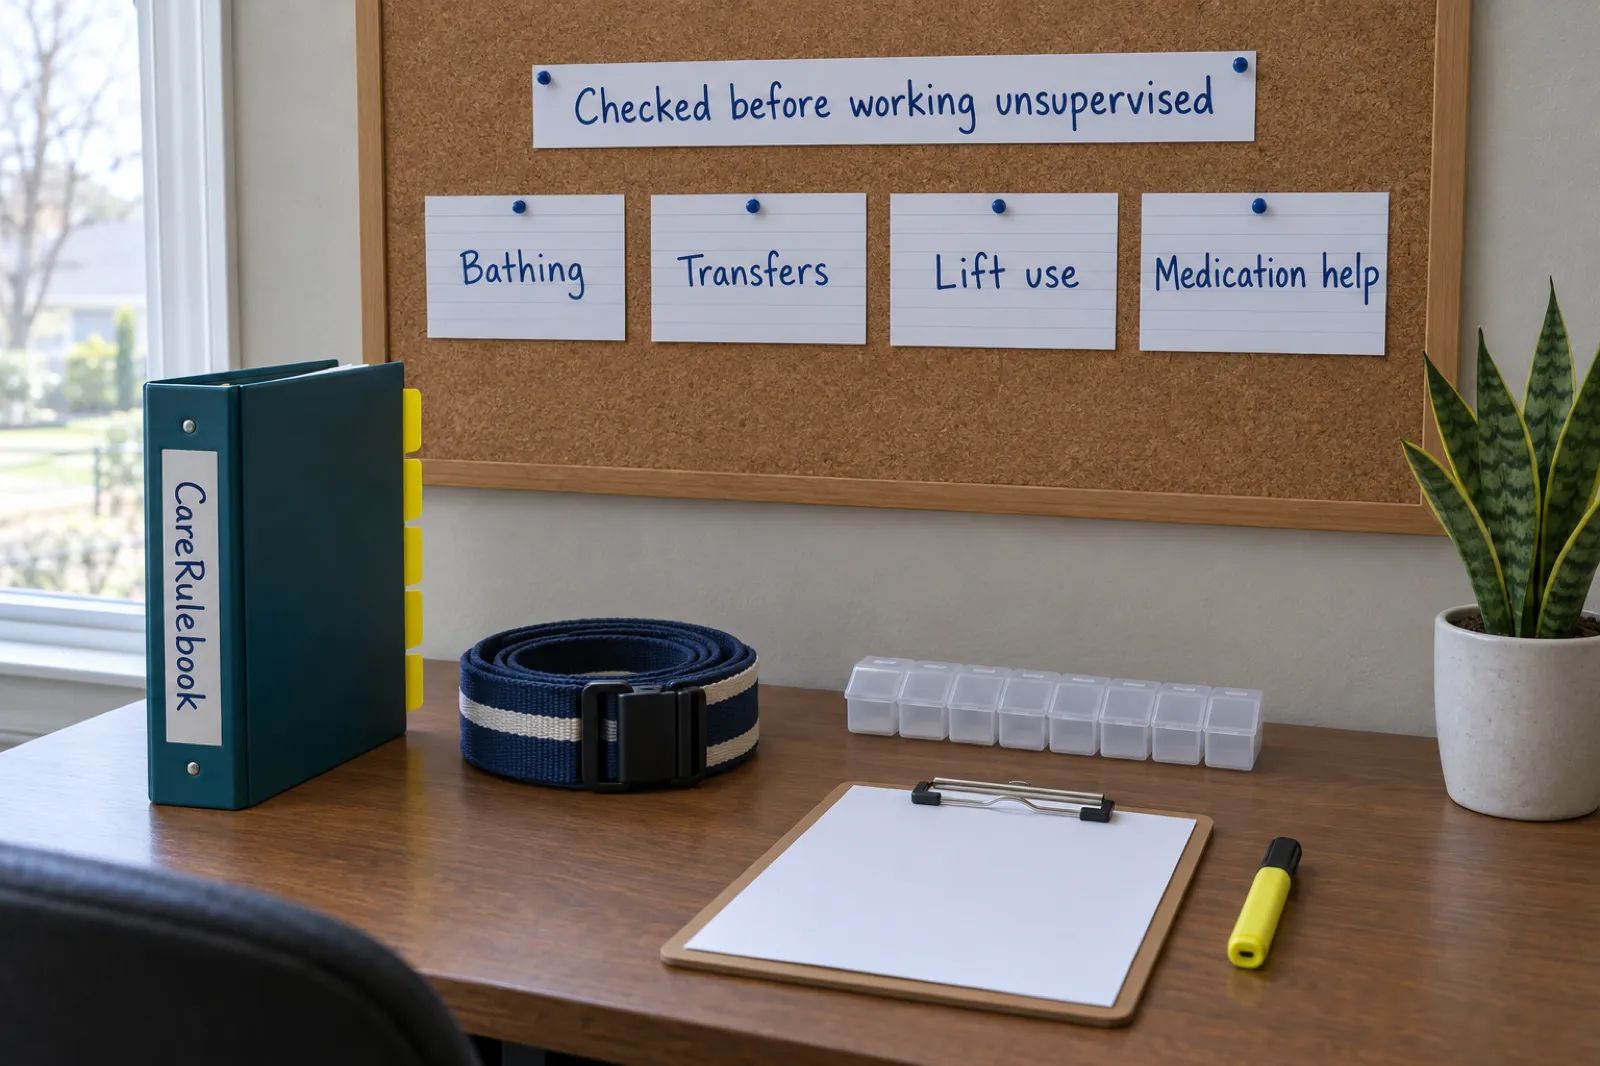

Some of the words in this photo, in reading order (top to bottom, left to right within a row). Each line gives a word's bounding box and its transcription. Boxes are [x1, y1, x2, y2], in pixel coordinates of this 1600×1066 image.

[575, 83, 712, 126] Checked
[729, 82, 831, 121] before
[849, 78, 977, 135] working
[995, 74, 1215, 133] unsupervised
[459, 248, 585, 301] Bathing
[676, 249, 829, 288] Transfers
[935, 251, 1006, 291] Lift
[1025, 265, 1080, 289] use
[1155, 251, 1307, 292] Medication
[1322, 251, 1380, 306] help
[174, 481, 207, 712] CareRulebook
